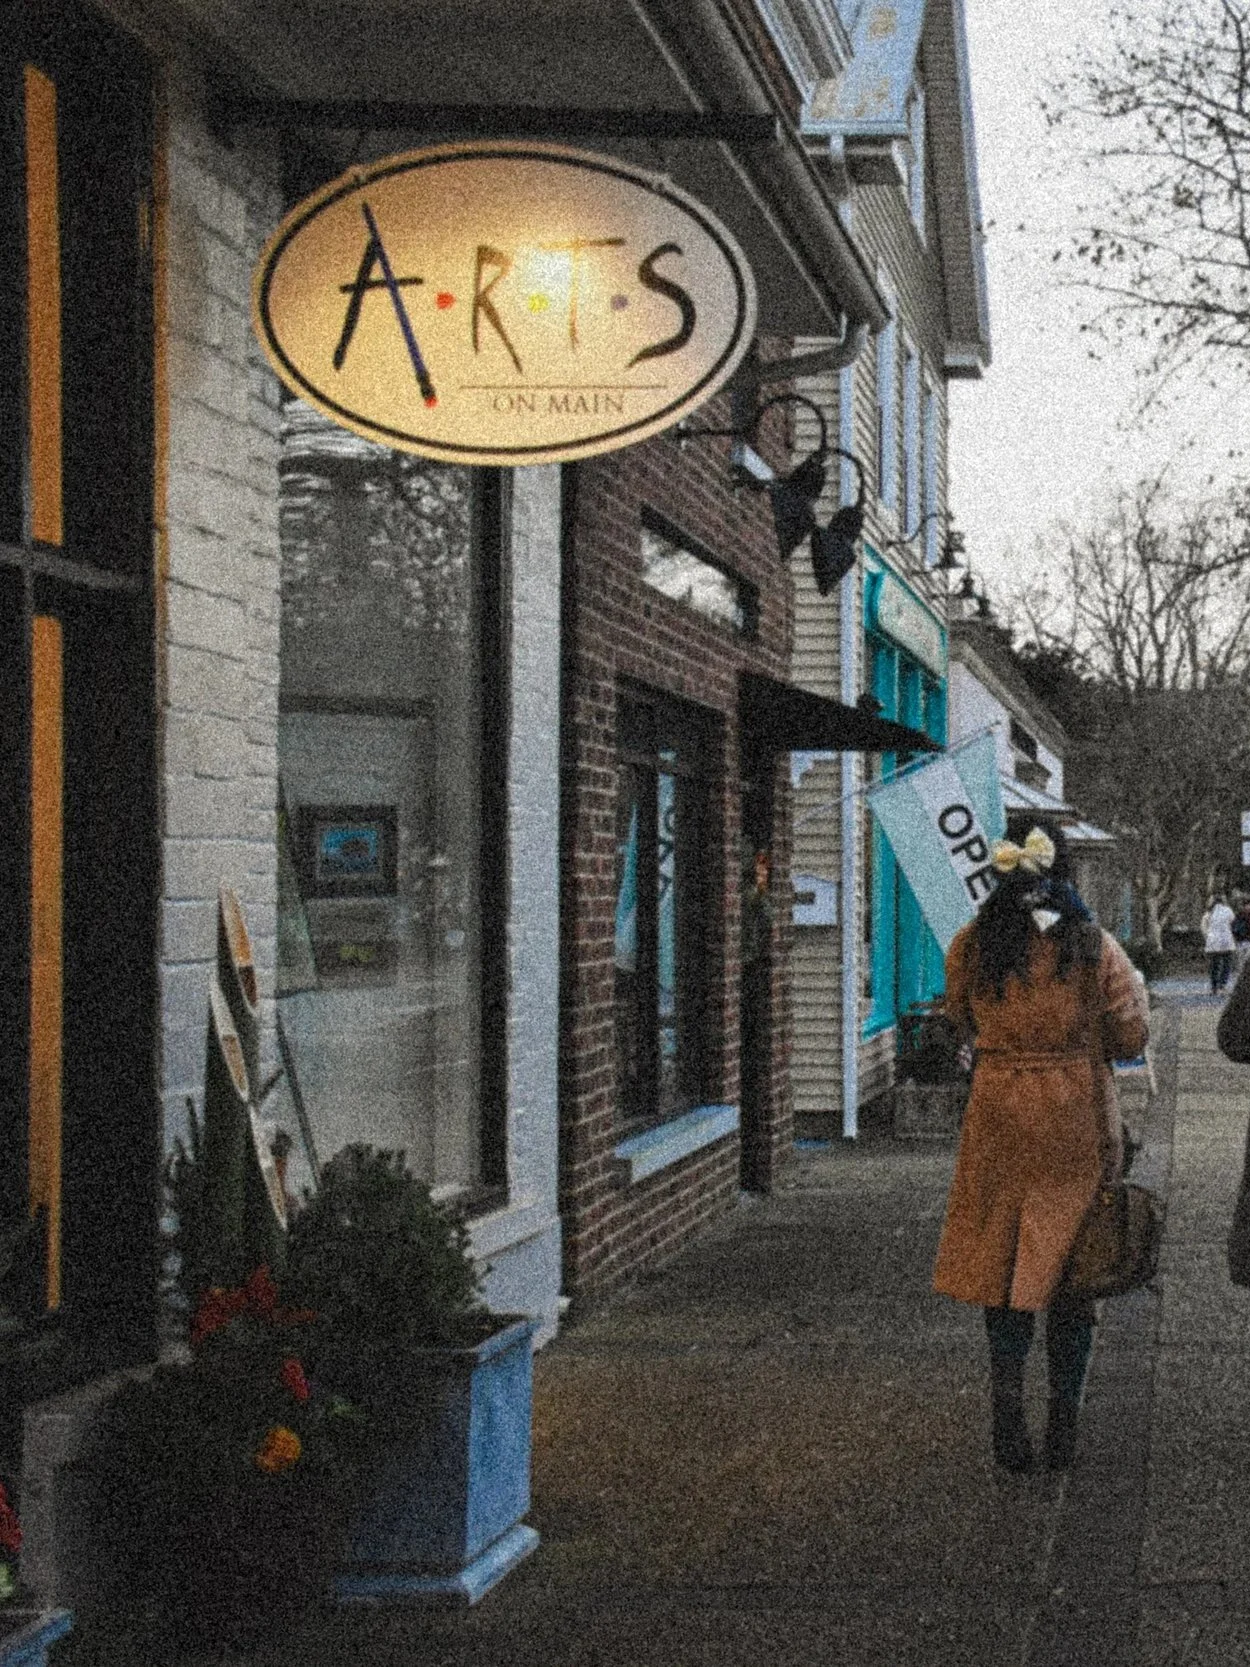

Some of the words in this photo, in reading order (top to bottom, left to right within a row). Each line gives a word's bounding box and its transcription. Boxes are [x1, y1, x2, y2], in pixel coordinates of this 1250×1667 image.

[493, 392, 536, 413] ON
[548, 392, 625, 414] MAIN
[937, 803, 998, 902] OPE
